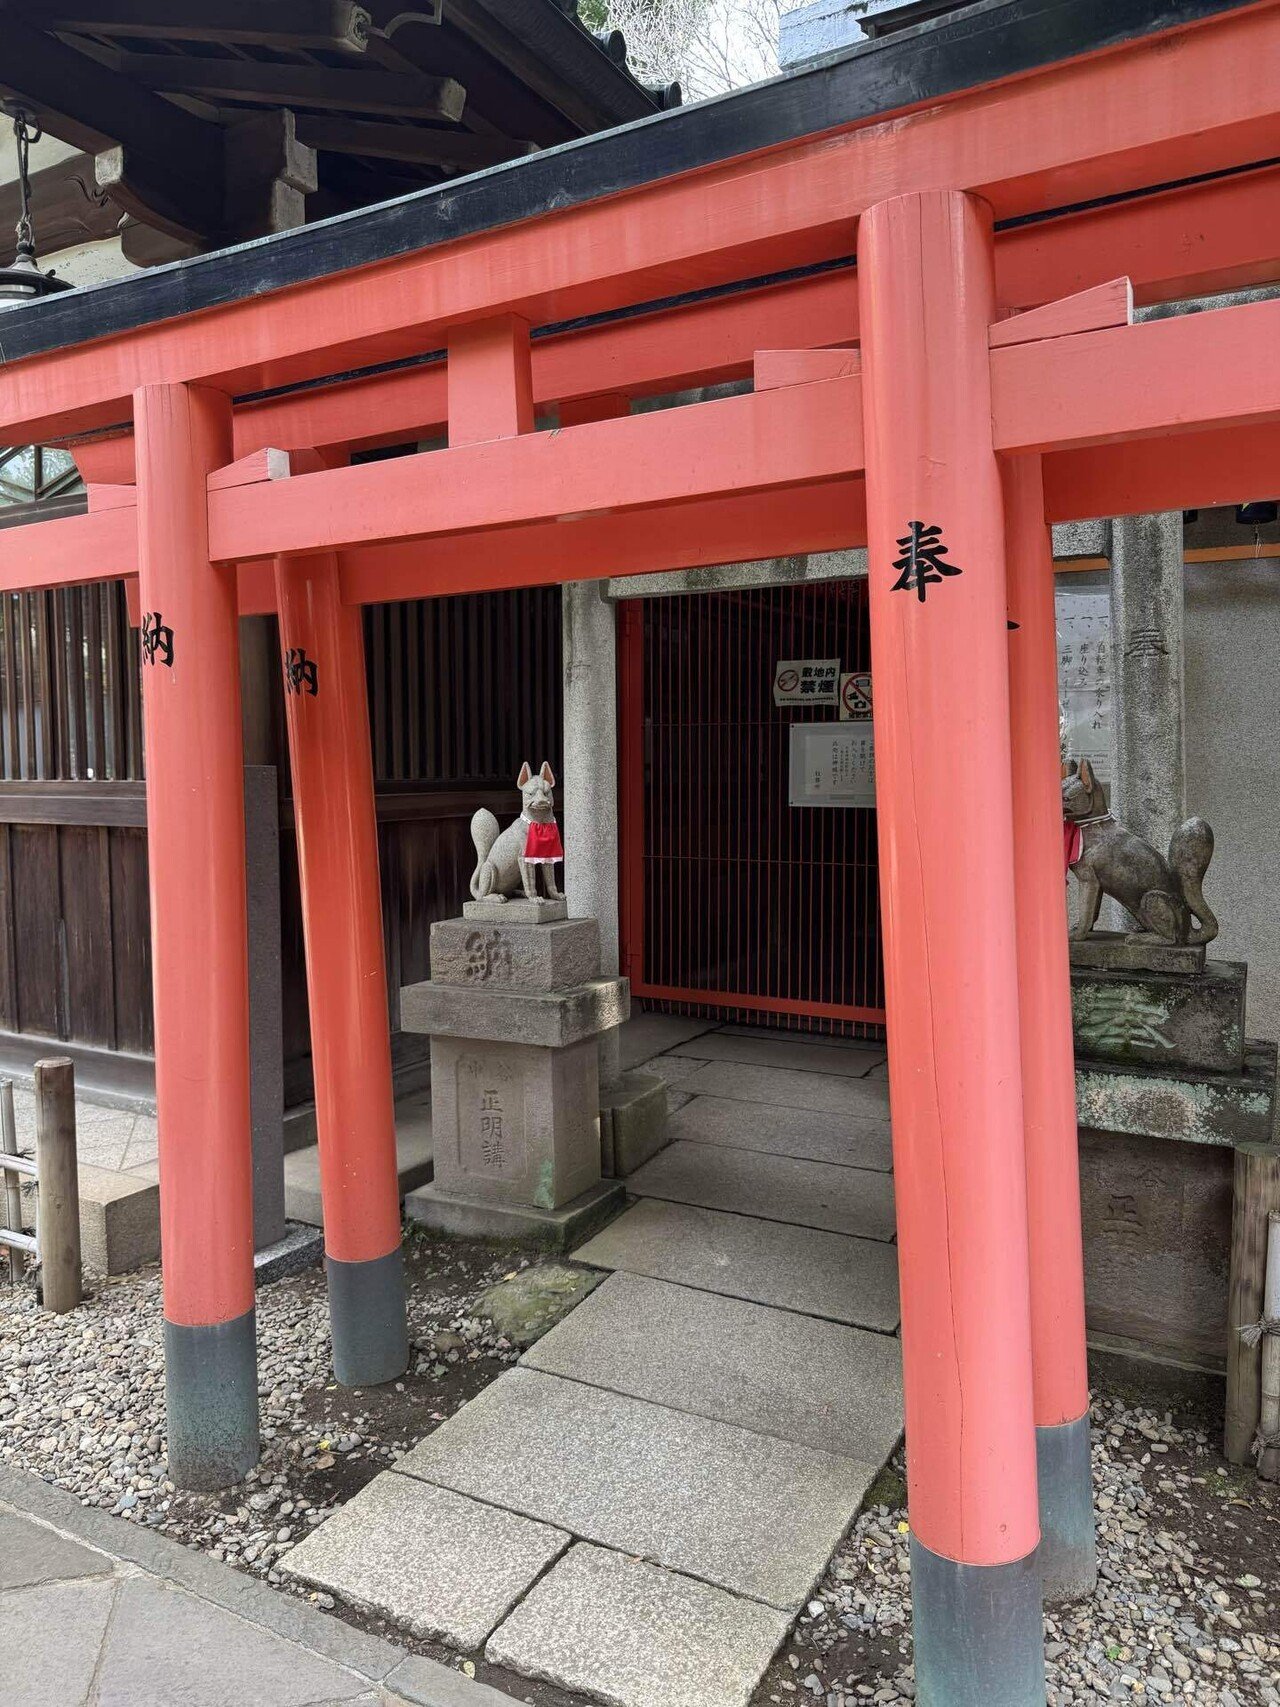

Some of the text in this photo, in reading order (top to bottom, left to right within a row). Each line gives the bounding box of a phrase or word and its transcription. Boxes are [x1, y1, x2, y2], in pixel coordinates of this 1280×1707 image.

[890, 521, 963, 603] 奉
[142, 612, 175, 668] 納
[286, 648, 319, 697] 納
[800, 680, 835, 694] 禁煙
